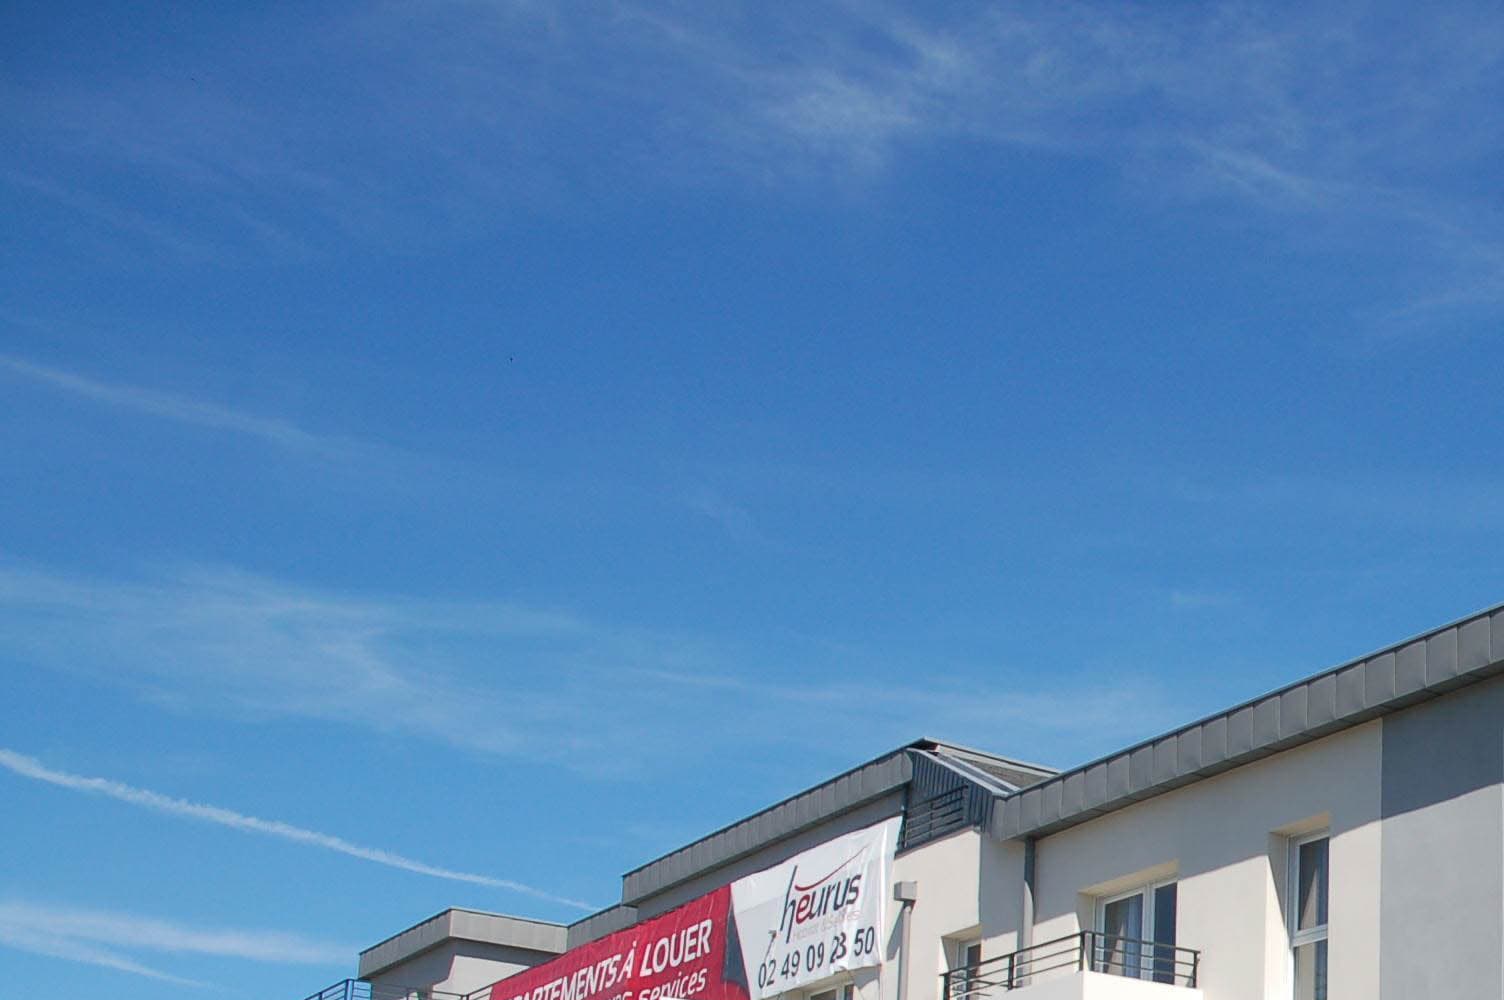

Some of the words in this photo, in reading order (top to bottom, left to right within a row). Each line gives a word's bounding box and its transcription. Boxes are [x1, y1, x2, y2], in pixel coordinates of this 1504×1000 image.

[780, 865, 862, 944] heurus
[639, 918, 713, 977] LOUER
[758, 959, 777, 989] 02
[781, 951, 800, 981] 49
[806, 942, 825, 973] 09
[829, 932, 848, 964] 23
[854, 926, 875, 957] 50
